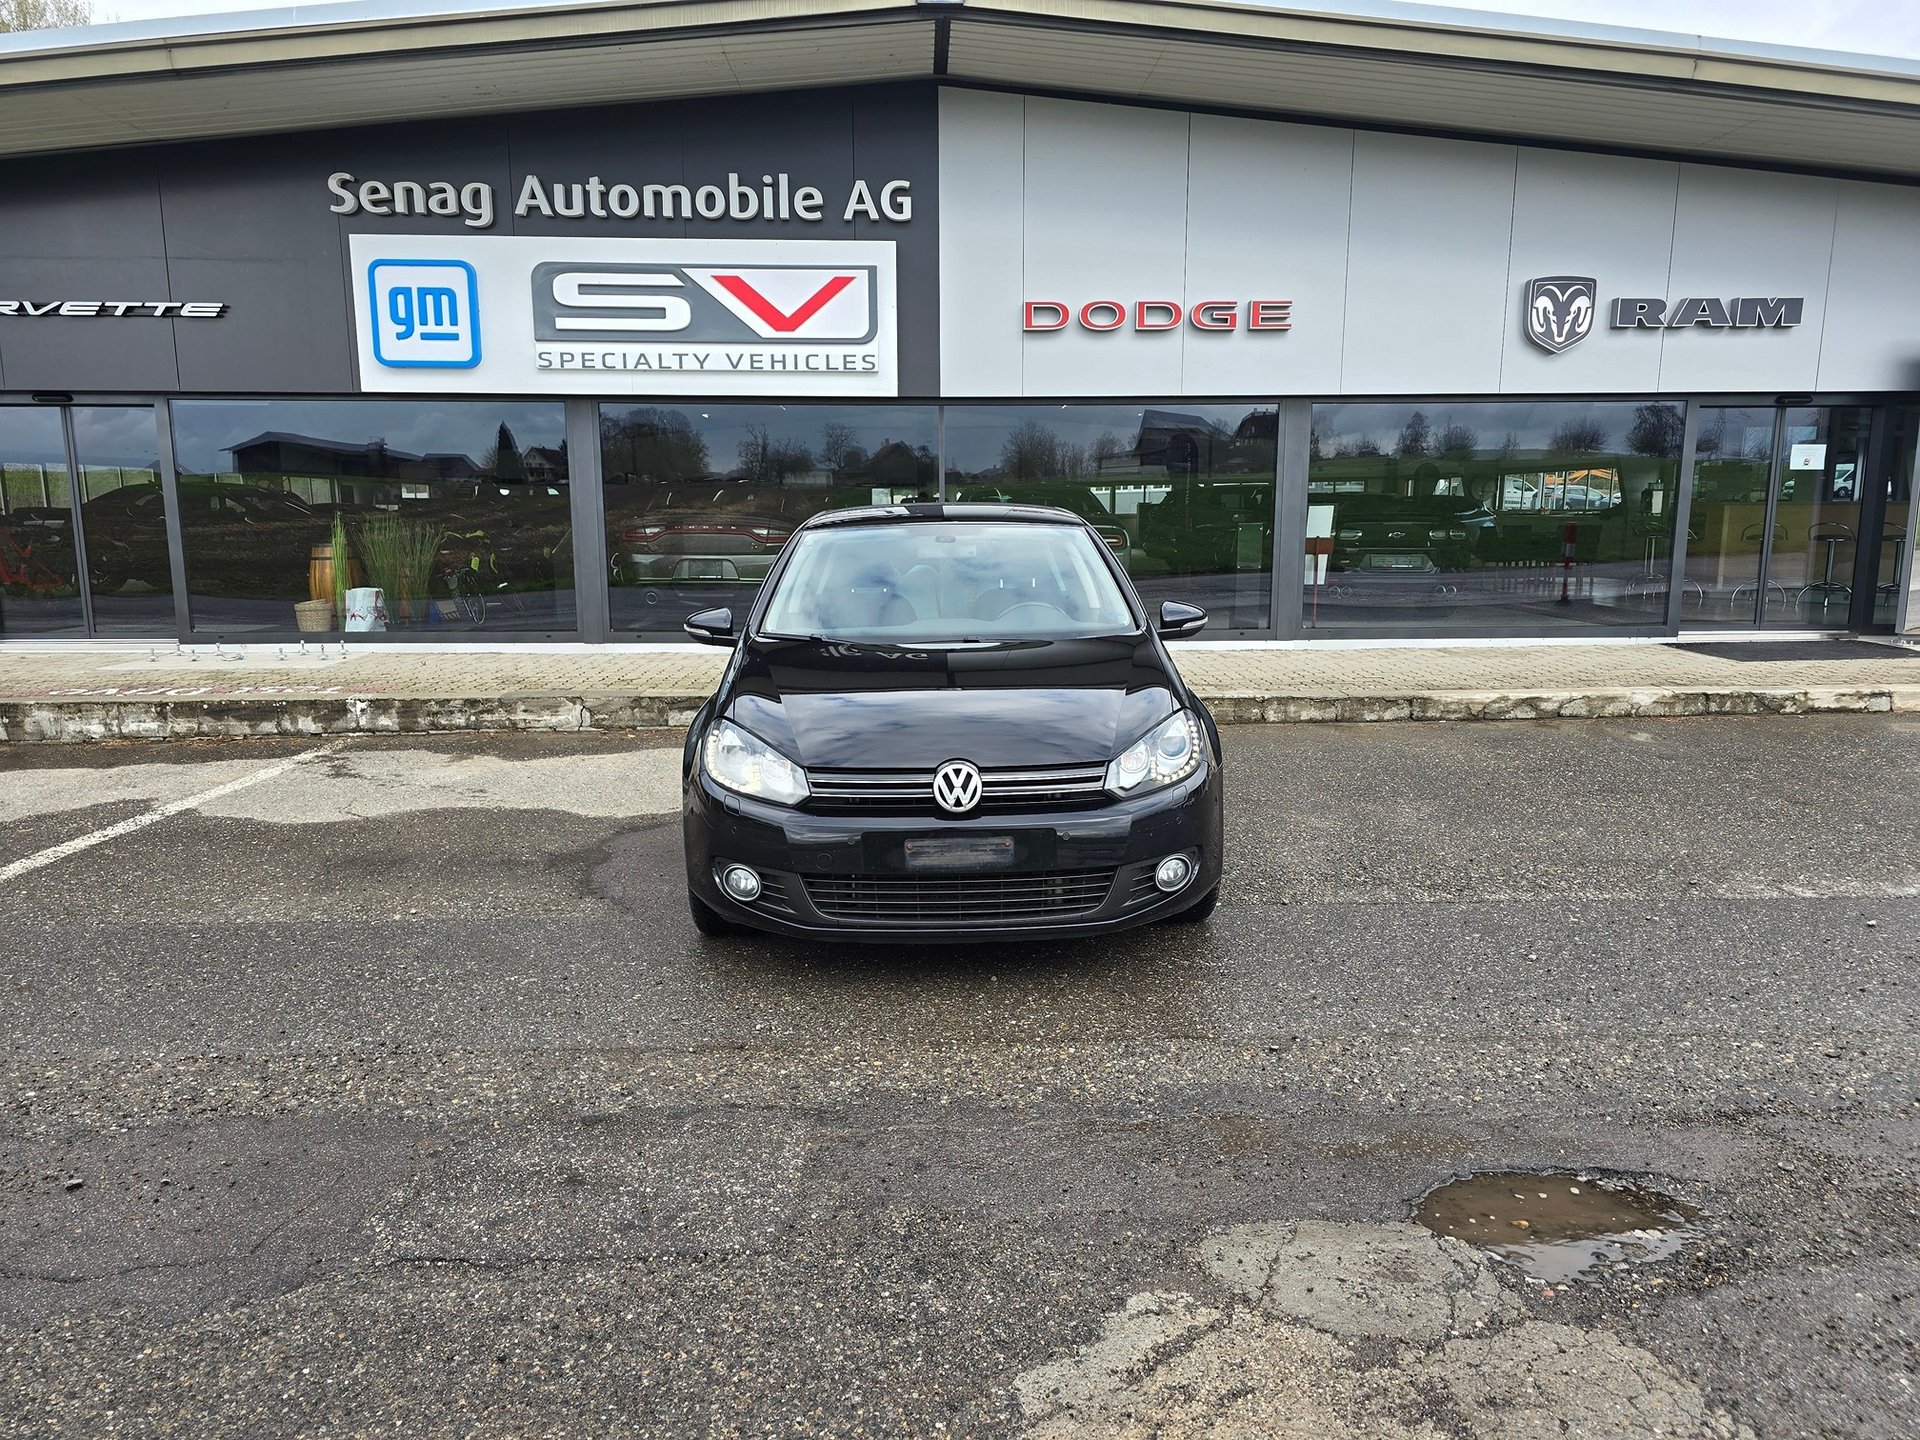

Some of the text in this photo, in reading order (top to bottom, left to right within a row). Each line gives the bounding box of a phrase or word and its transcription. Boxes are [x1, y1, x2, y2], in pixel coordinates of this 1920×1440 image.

[327, 172, 912, 228] Senag Automobile AG
[388, 286, 459, 340] gm
[1023, 300, 1293, 331] DODGE
[1611, 297, 1804, 329] RAM
[538, 351, 877, 371] SPECIALTY VEHICLES
[933, 762, 982, 812] VW
